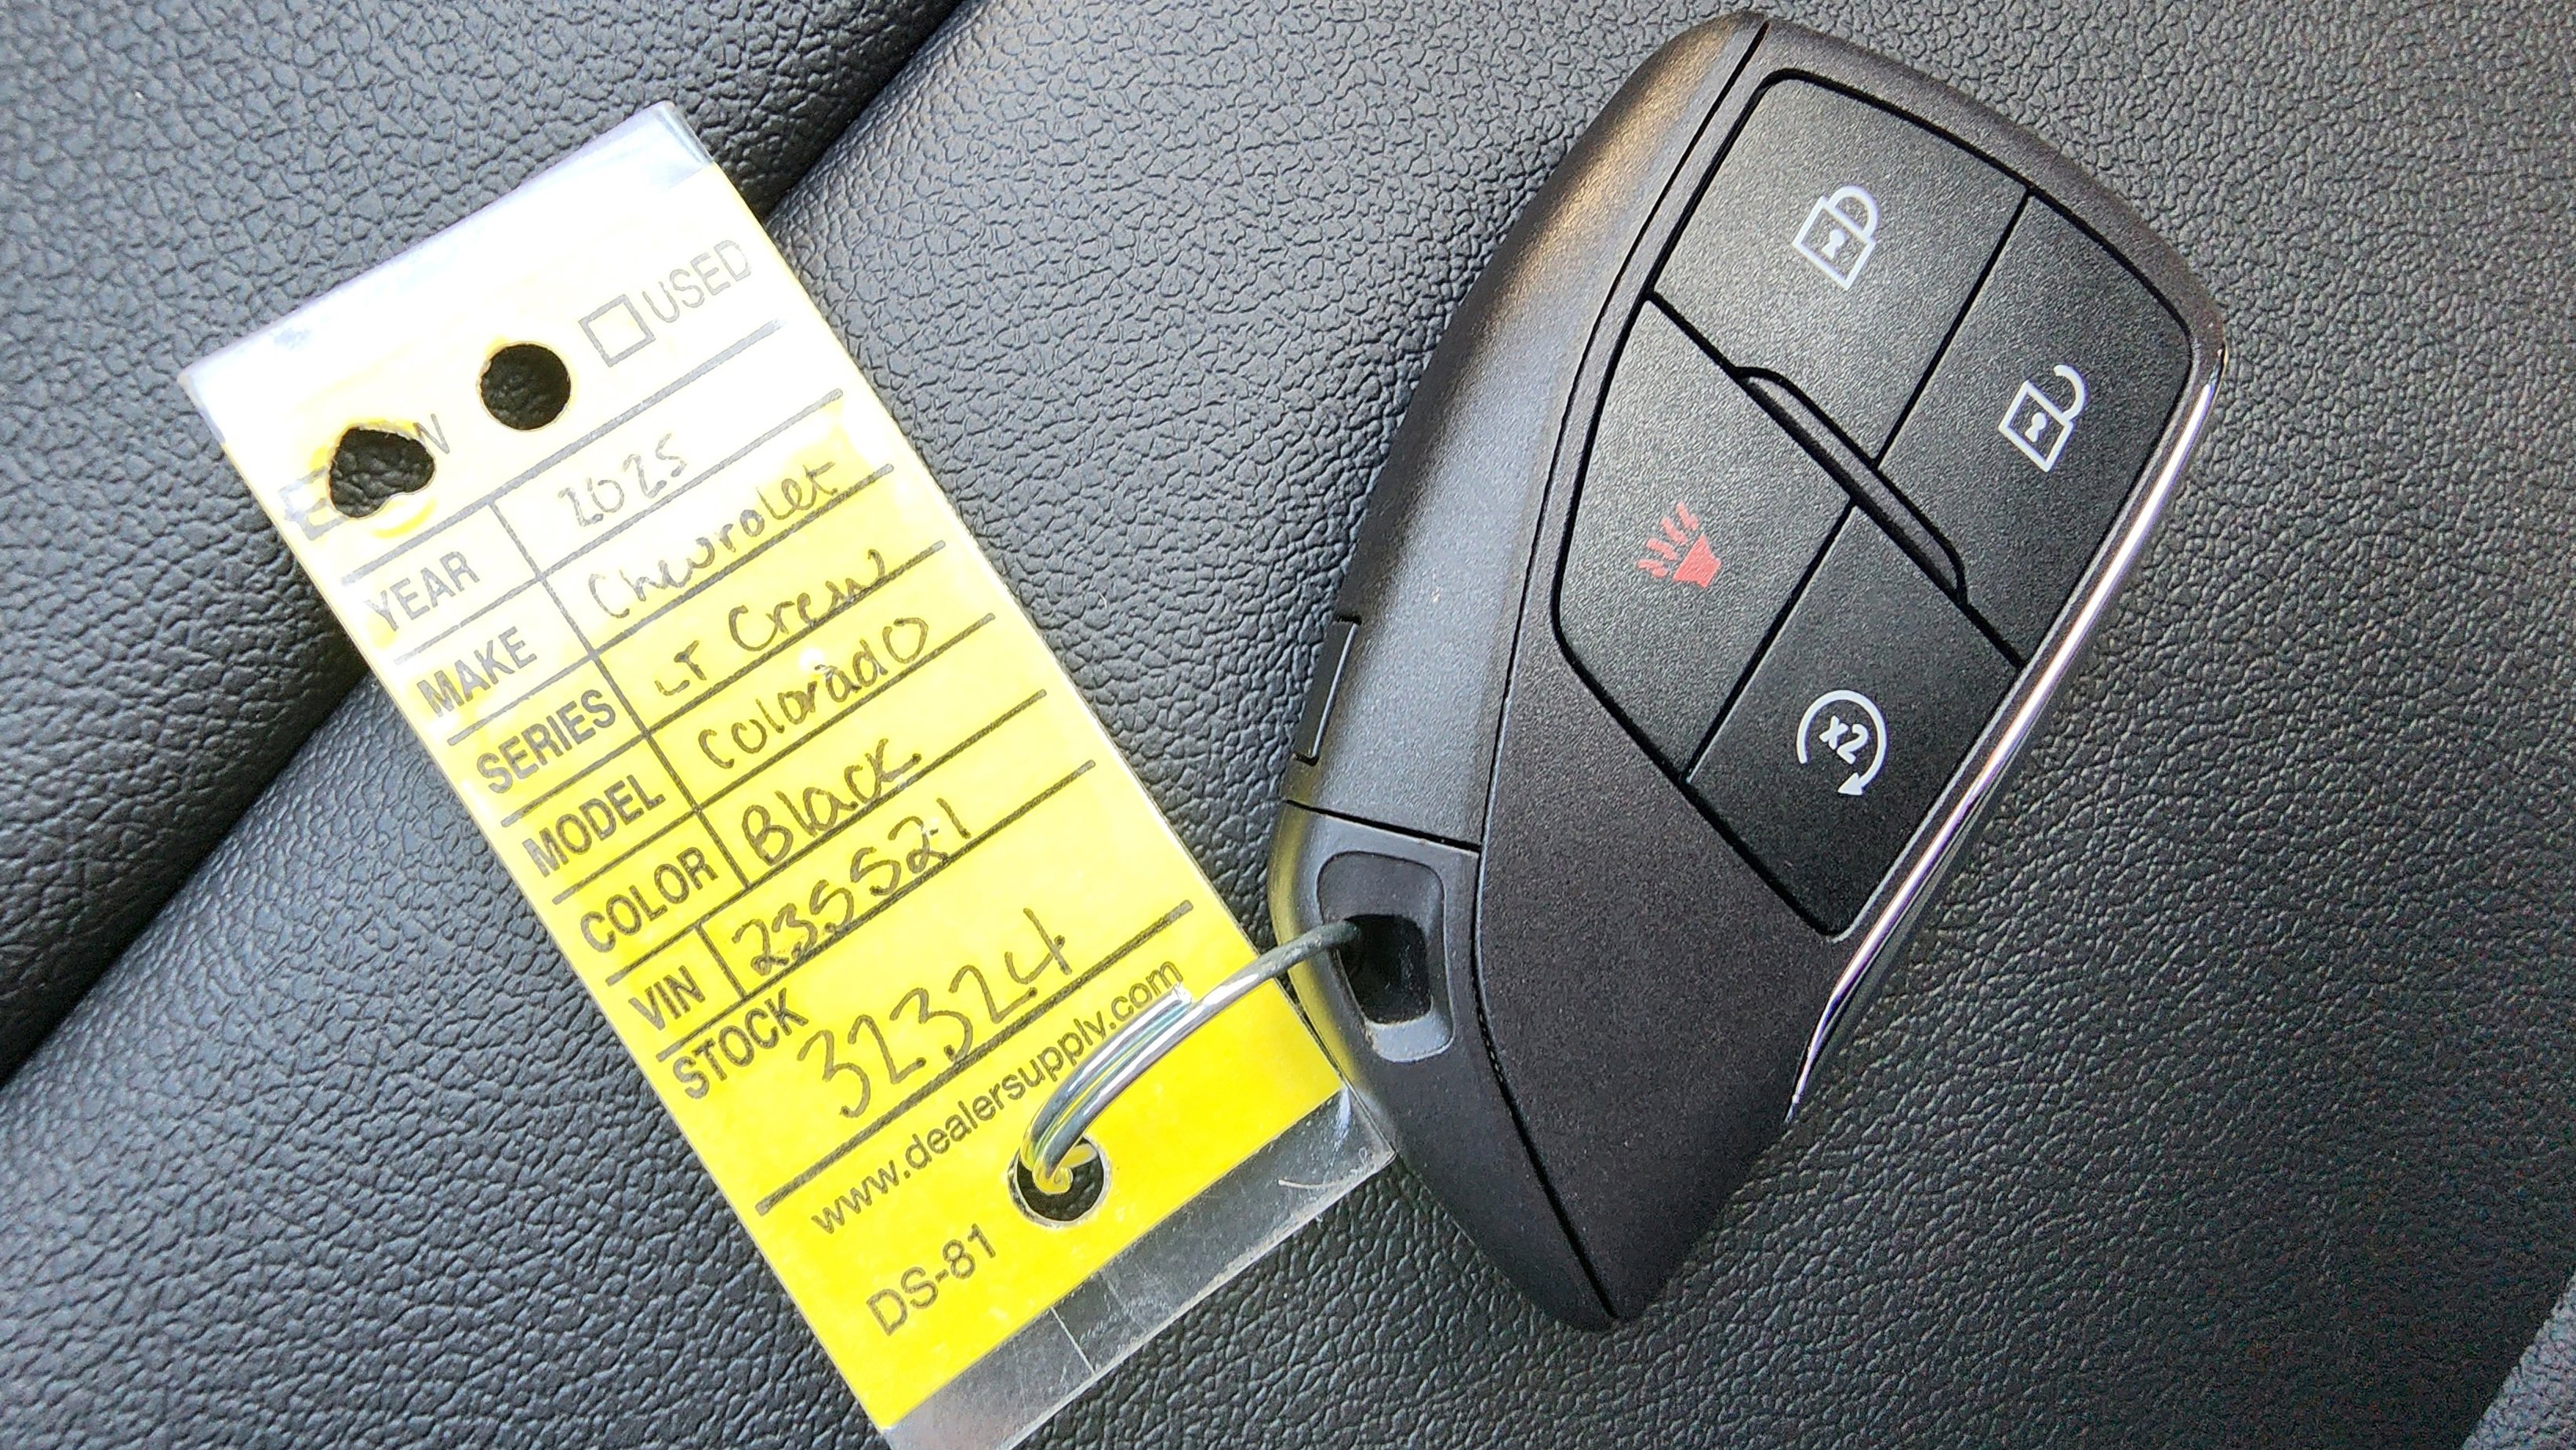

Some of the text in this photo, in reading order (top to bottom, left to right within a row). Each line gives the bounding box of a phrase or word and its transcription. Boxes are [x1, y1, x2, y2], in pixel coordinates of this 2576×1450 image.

[643, 239, 753, 325] USED
[558, 433, 689, 529] 2025
[365, 551, 480, 632] YEAR
[587, 461, 841, 620] Chevrolet
[728, 549, 885, 652] Crew
[416, 627, 537, 717] MAKE
[478, 689, 616, 794] SERIES
[521, 772, 665, 878] MODEL
[580, 847, 719, 953] COLOR
[628, 967, 706, 1034] VIN
[672, 988, 809, 1099] STOCK
[798, 907, 1073, 1119] 32324
[810, 959, 1184, 1235] www.dealersupply.com
[865, 1222, 998, 1336] DS-81
